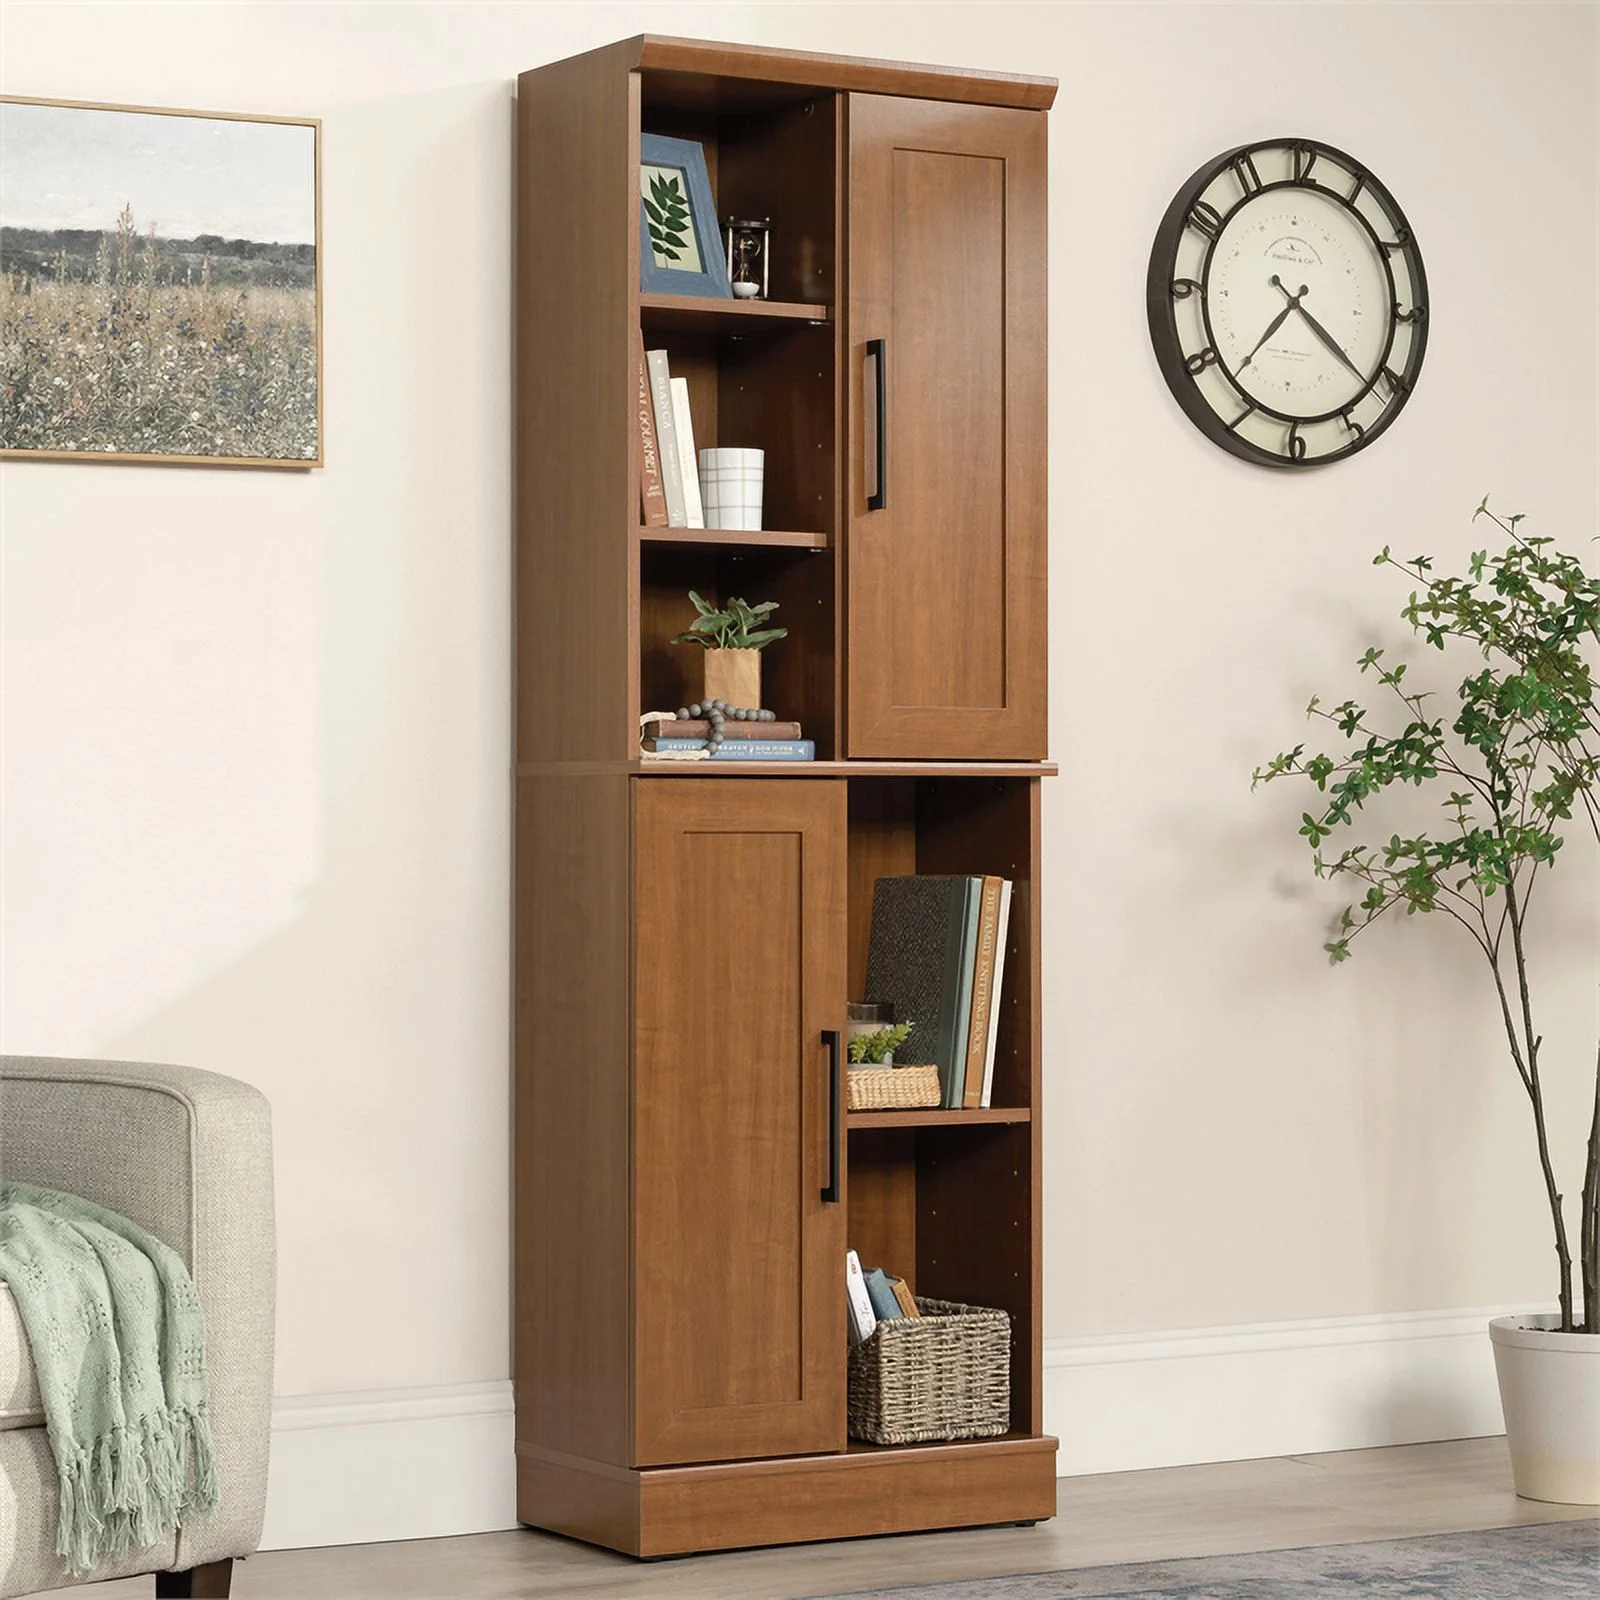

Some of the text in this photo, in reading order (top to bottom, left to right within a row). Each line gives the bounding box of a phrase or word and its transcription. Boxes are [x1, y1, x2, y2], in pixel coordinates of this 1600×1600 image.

[1230, 149, 1262, 198] 11
[1289, 141, 1317, 184] 12
[1346, 172, 1366, 206] 1
[1186, 200, 1224, 242] 10
[1379, 228, 1412, 259] 2
[1171, 277, 1207, 299] 9
[1394, 302, 1425, 323] 3
[1185, 347, 1217, 375] 8
[1381, 365, 1410, 395] 4
[1227, 396, 1257, 431] 7
[1341, 405, 1365, 446] 5
[1289, 418, 1307, 462] 6
